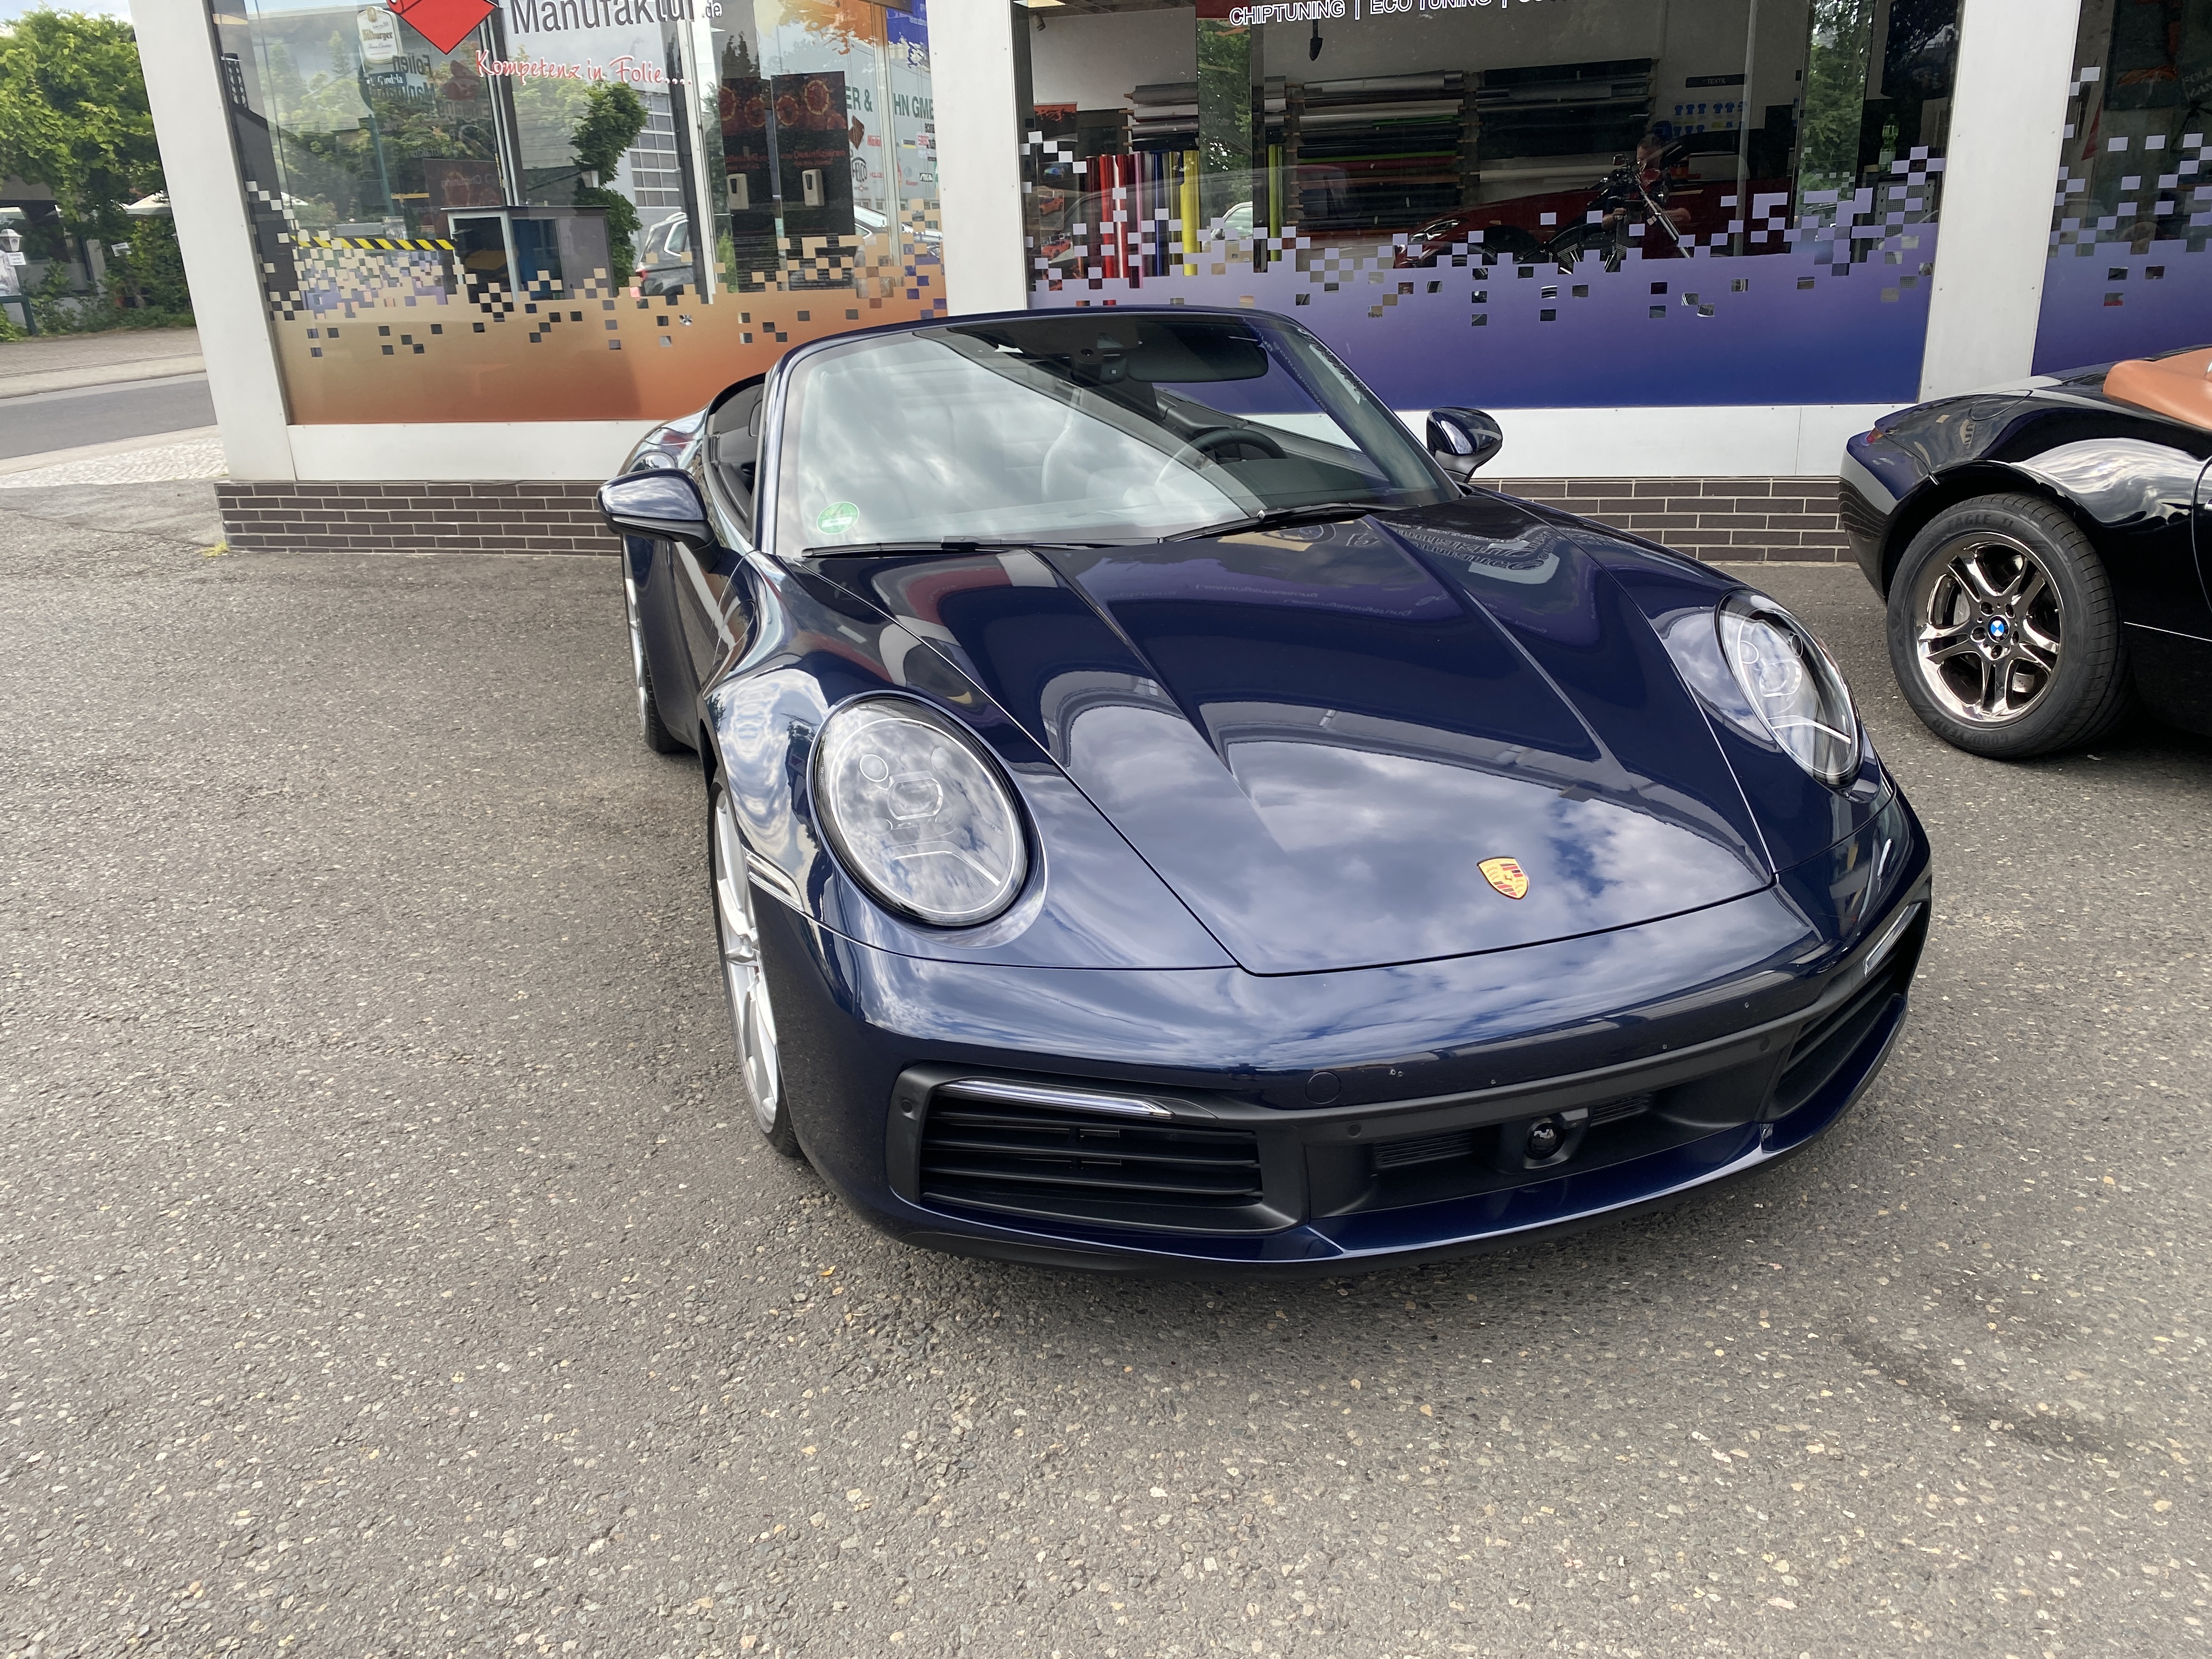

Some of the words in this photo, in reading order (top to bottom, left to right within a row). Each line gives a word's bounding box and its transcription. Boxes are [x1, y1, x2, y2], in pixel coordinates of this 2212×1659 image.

[1229, 0, 1346, 26] CHIPTUNING
[475, 49, 582, 86] Kompetenz
[587, 58, 605, 80] in
[864, 89, 873, 112] &
